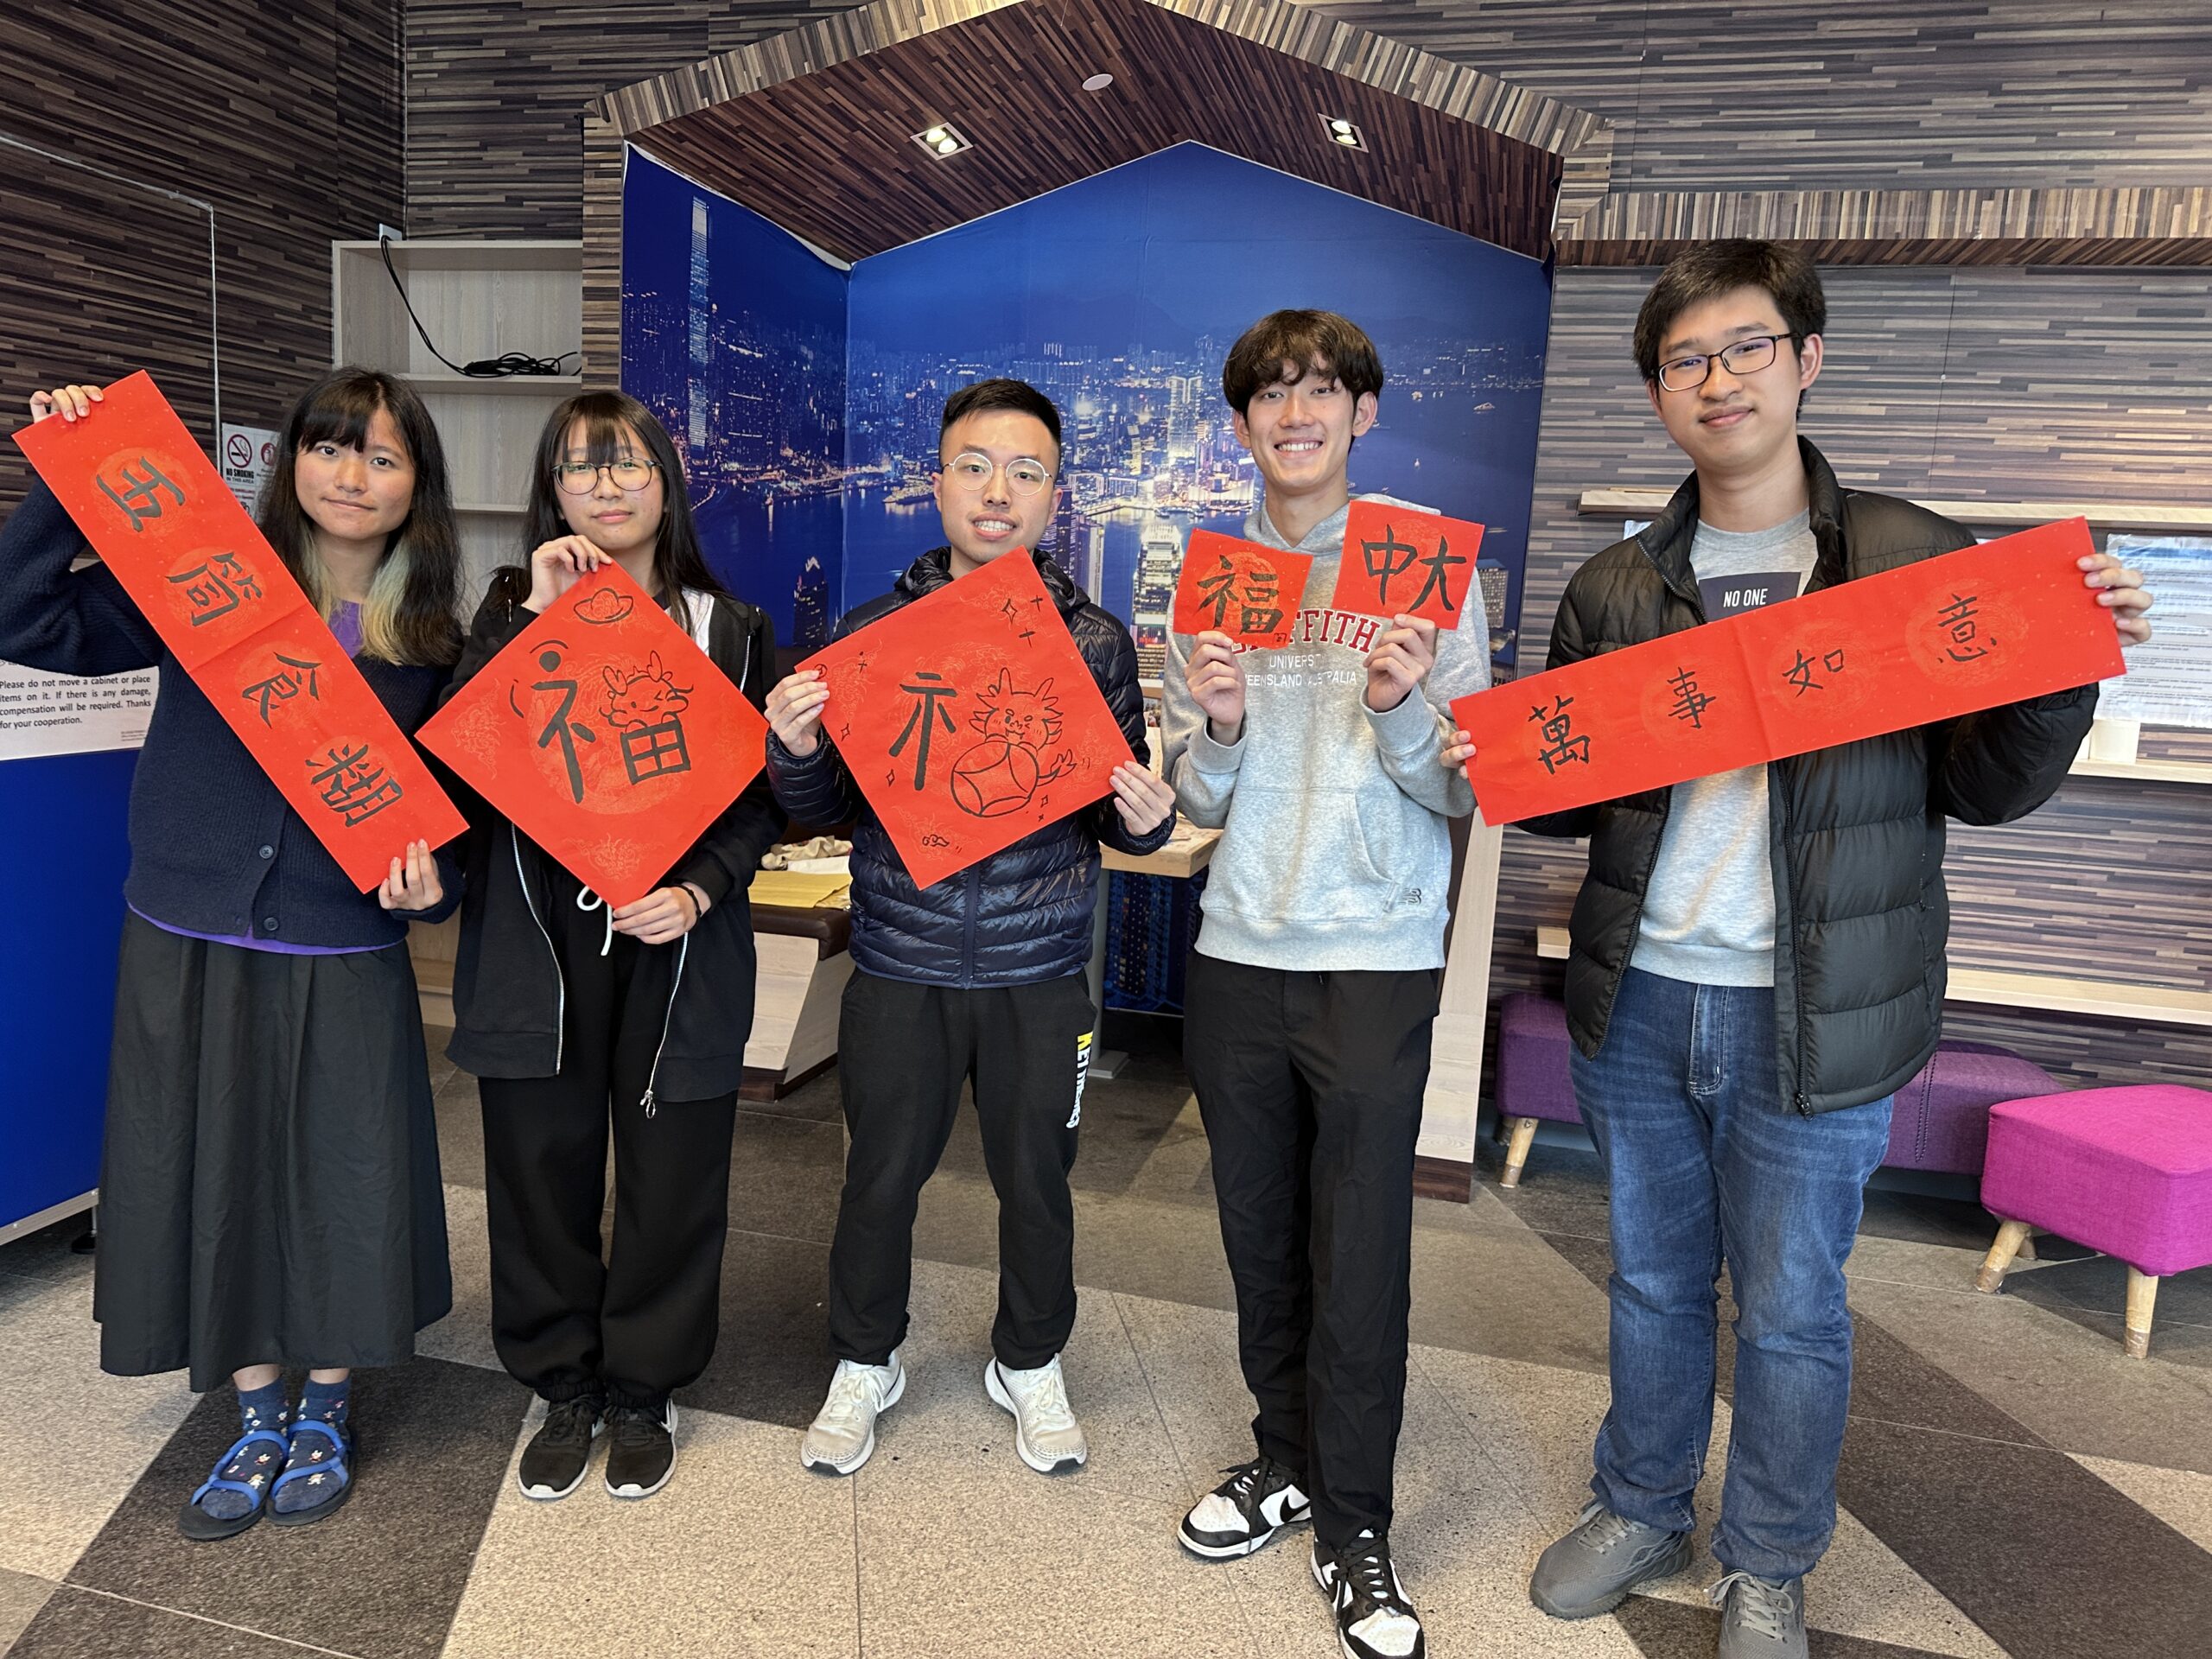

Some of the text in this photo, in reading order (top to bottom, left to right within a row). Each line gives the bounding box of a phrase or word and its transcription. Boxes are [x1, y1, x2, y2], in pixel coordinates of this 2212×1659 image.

[233, 468, 254, 479] SMOKING
[1198, 555, 1284, 635] 福
[1723, 588, 1768, 607] NO ONE
[1269, 654, 1322, 669] UNIVERS
[0, 681, 24, 690] Please
[29, 679, 39, 688] do
[91, 676, 118, 685] cabinet
[132, 675, 150, 685] place
[1528, 593, 1997, 775] 萬事如意
[0, 693, 21, 702] items
[42, 692, 51, 701] it.
[67, 690, 87, 699] there
[103, 690, 116, 699] any
[121, 688, 151, 698] damage,
[0, 699, 151, 716] compensation will be required. Thanks
[0, 715, 83, 730] for your cooperation.
